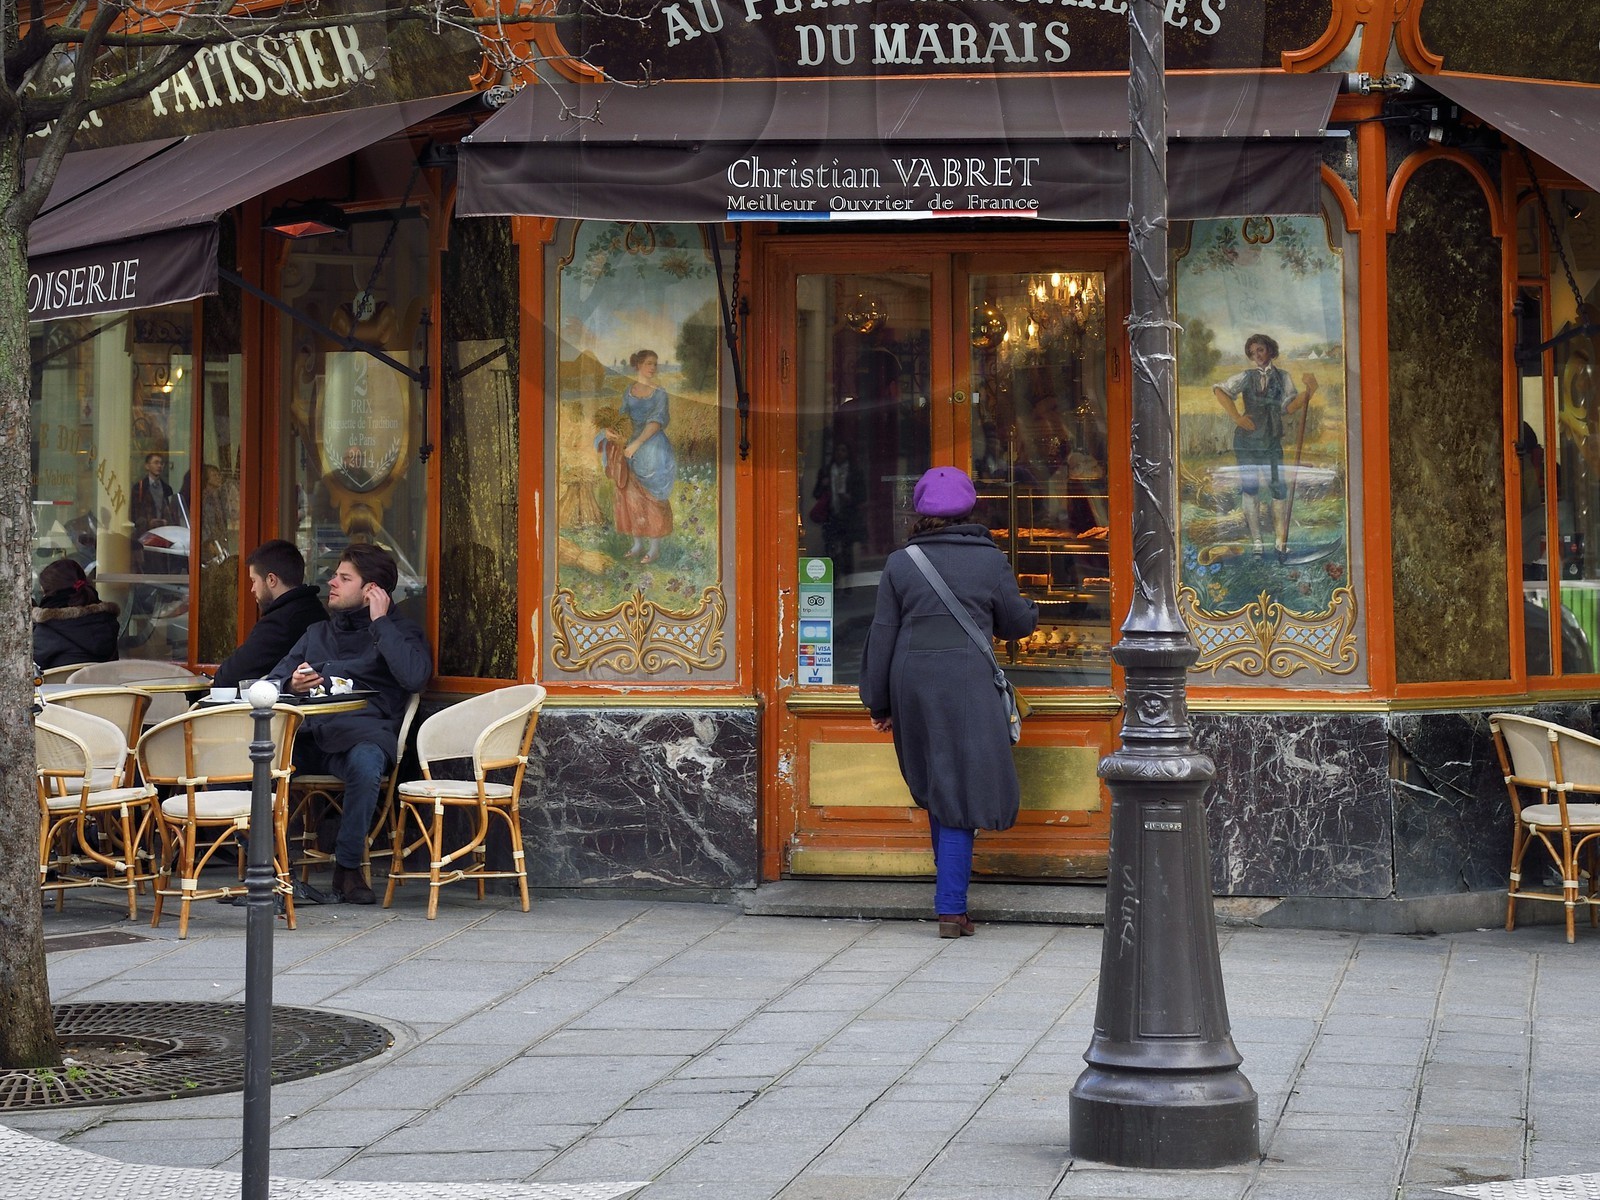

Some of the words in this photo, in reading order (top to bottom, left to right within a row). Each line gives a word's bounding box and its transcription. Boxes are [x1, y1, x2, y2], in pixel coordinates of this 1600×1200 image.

[796, 22, 857, 66] DU
[871, 20, 1072, 66] MARAIS
[726, 155, 882, 189] Christian
[892, 157, 1040, 188] VABRET
[726, 193, 818, 211] Meilleur
[829, 193, 915, 211] Ouvrier
[928, 193, 955, 210] de
[967, 194, 1040, 211] France
[351, 399, 373, 414] PRIX
[368, 415, 399, 429] Tradition
[349, 432, 358, 446] de
[359, 432, 376, 447] Paris
[348, 449, 376, 468] 2014
